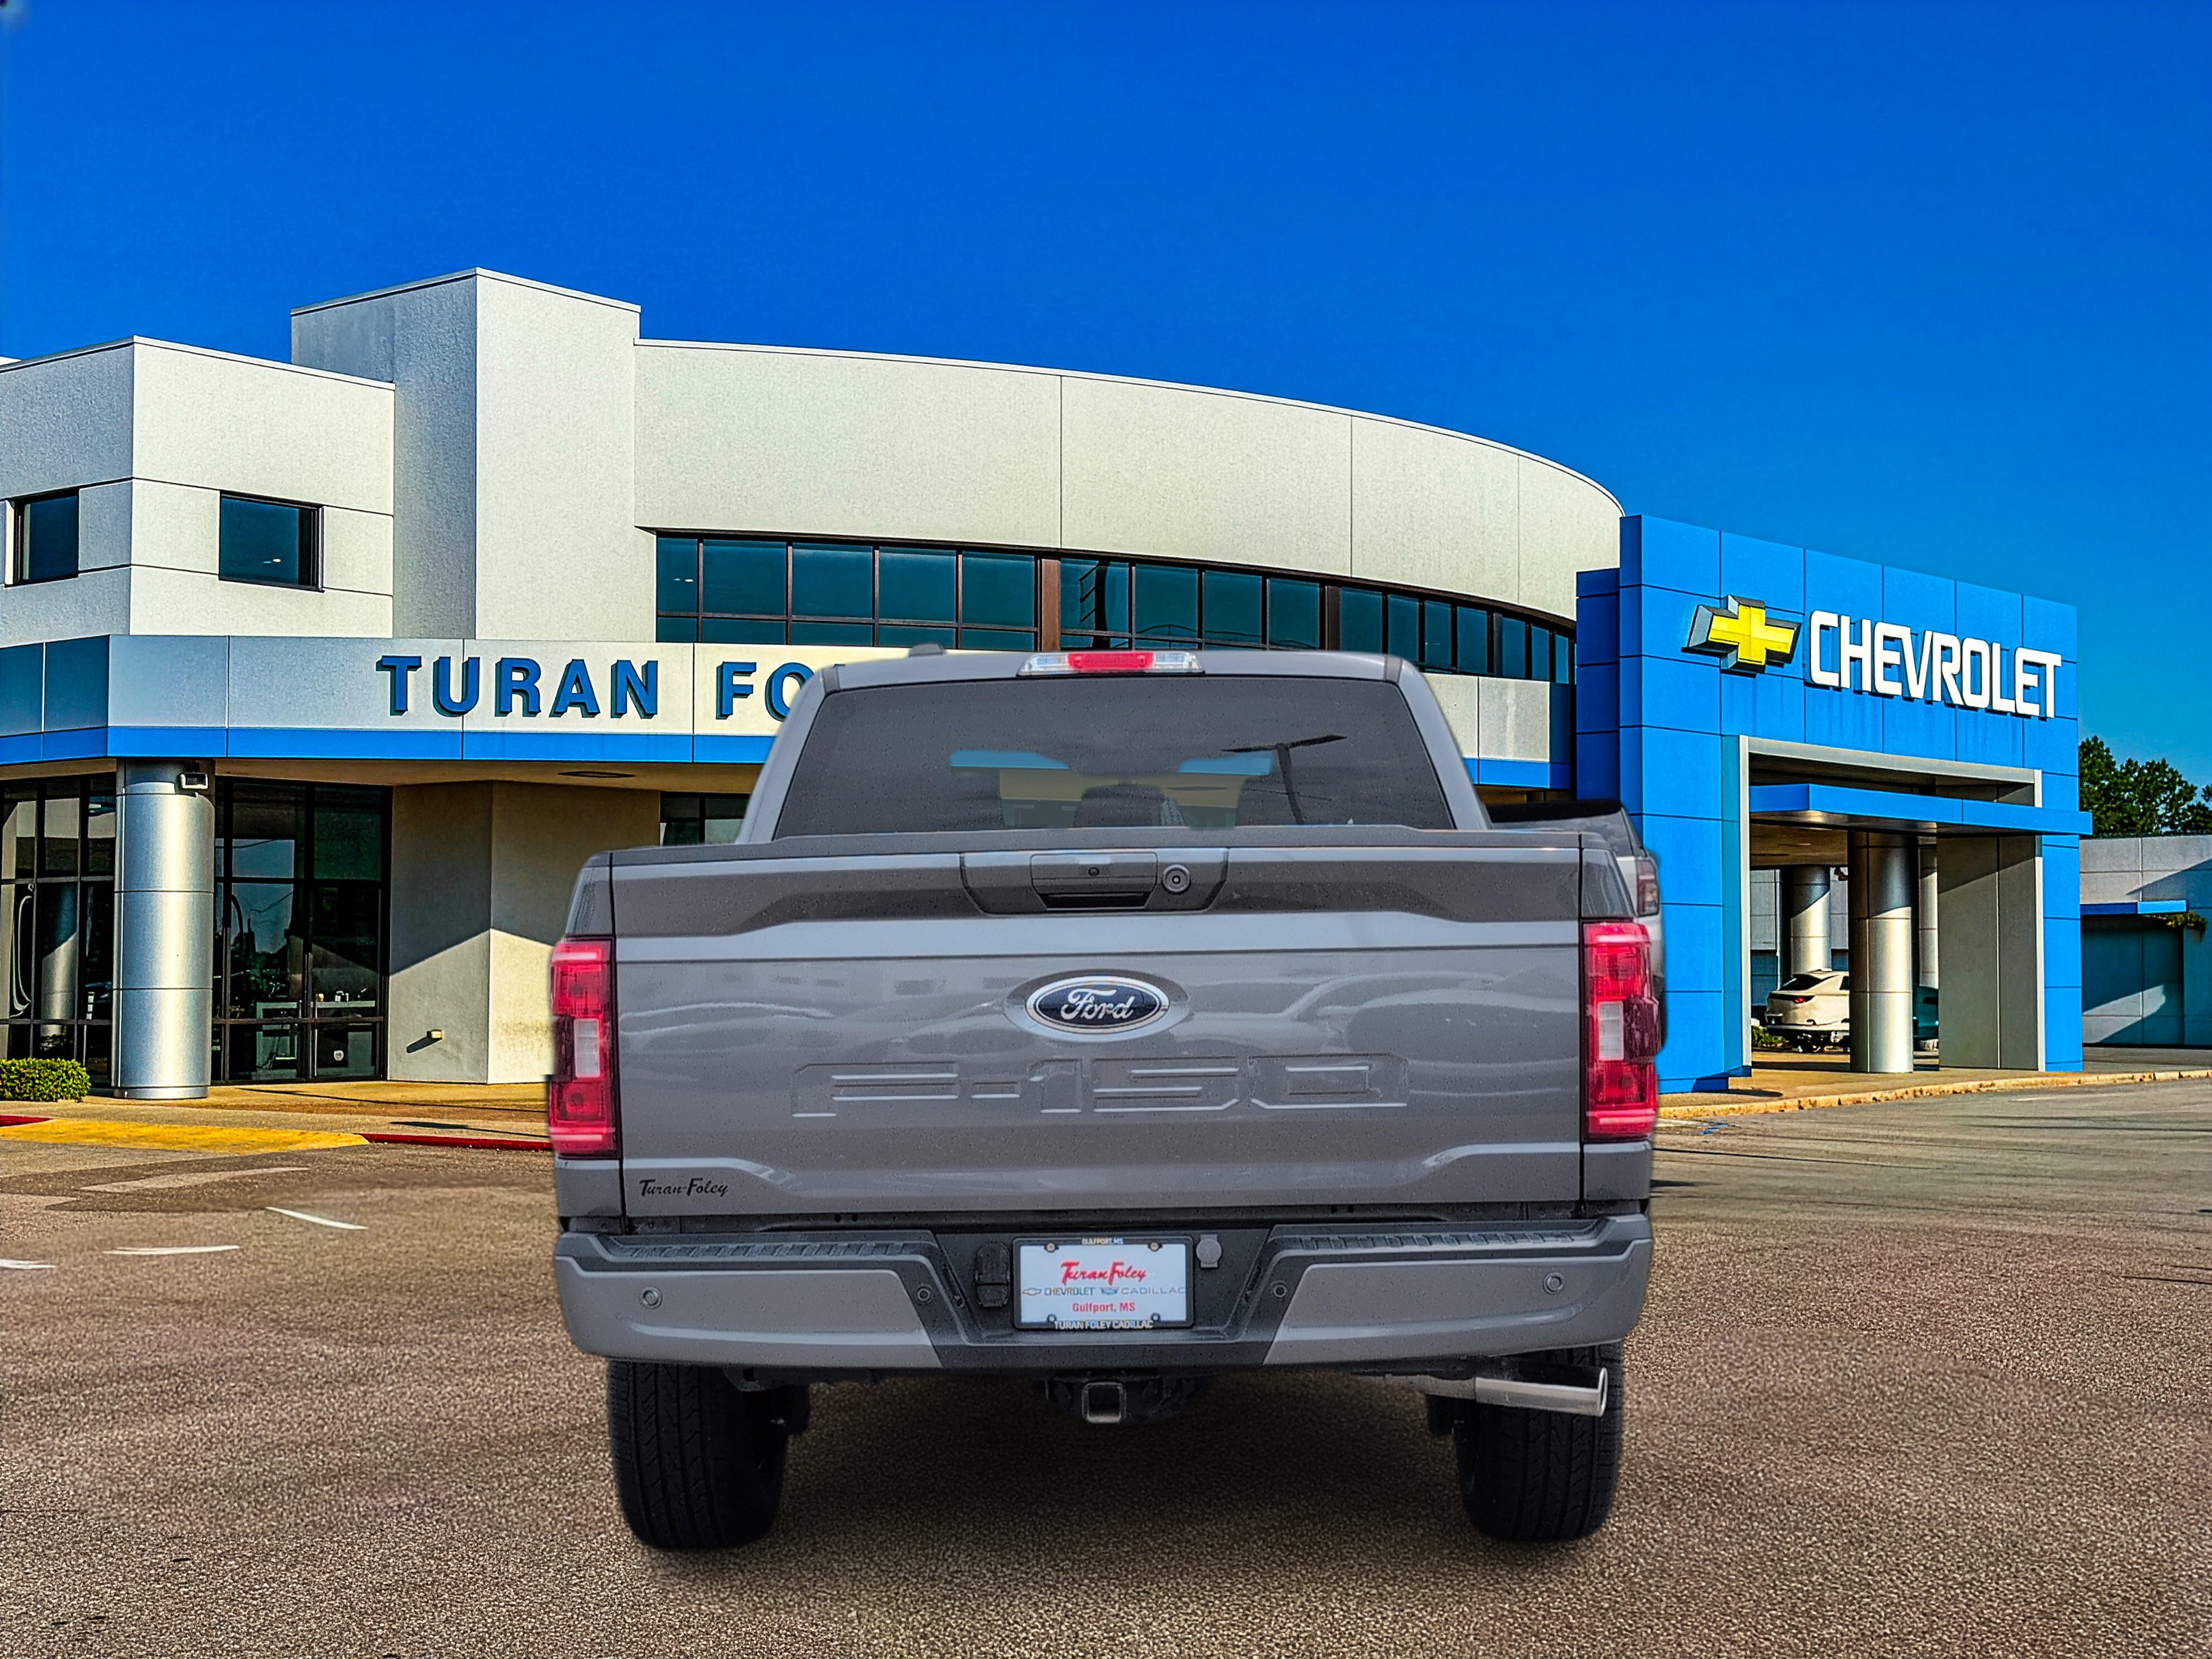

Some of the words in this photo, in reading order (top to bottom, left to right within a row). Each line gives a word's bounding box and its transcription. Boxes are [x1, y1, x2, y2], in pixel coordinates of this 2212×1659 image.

[1806, 610, 2062, 719] CHEVROLET
[376, 654, 658, 719] TURAN
[716, 661, 846, 722] FO
[1060, 988, 1136, 1020] Ford
[792, 1053, 1409, 1117] F-150
[1044, 1287, 1095, 1296] CHEVROLET
[1121, 1287, 1186, 1295] CADILLAC
[1072, 1302, 1117, 1313] Gulfport,
[1119, 1302, 1136, 1311] MS
[1054, 1321, 1084, 1329] TURAN
[1085, 1321, 1111, 1329] FOLEY
[1112, 1320, 1154, 1329] CADILLAC
